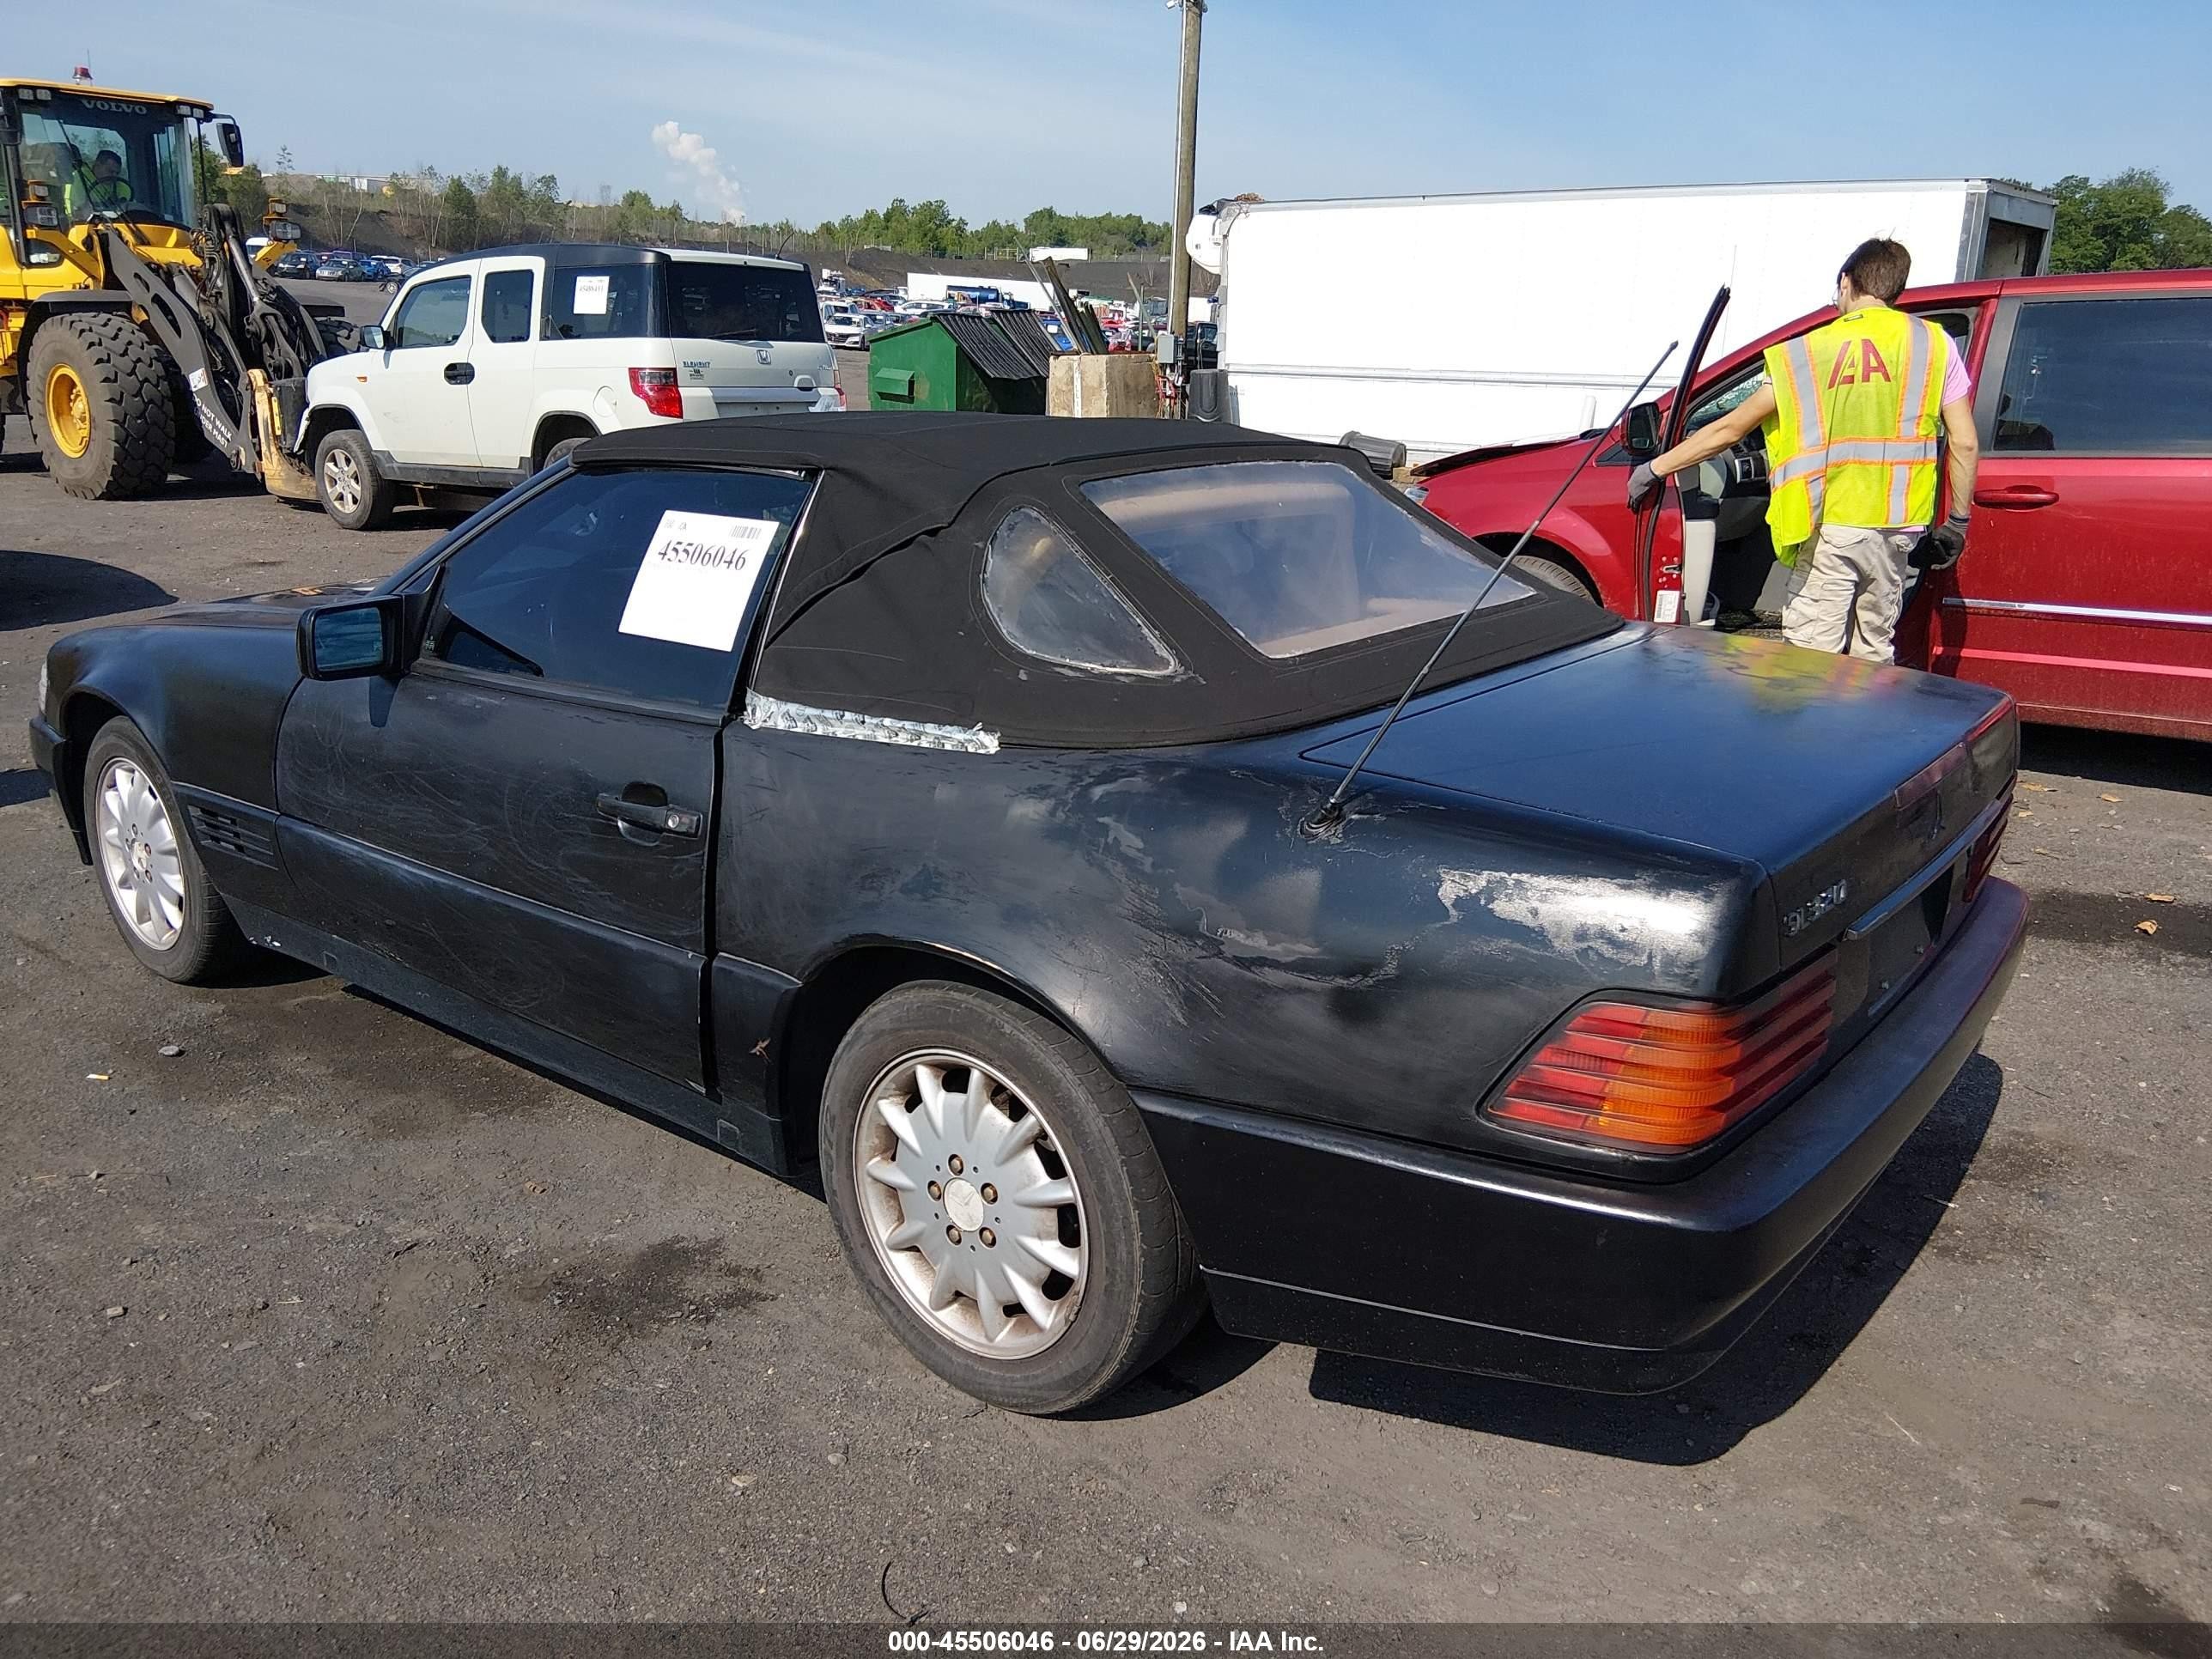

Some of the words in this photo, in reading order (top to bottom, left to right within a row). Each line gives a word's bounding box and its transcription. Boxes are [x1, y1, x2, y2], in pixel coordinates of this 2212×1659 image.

[82, 99, 148, 115] VOLVO
[683, 360, 711, 368] ELEMENT
[202, 404, 216, 422] NOT
[216, 416, 232, 441] WALK
[213, 428, 228, 448] MAST
[658, 539, 750, 571] 45506046
